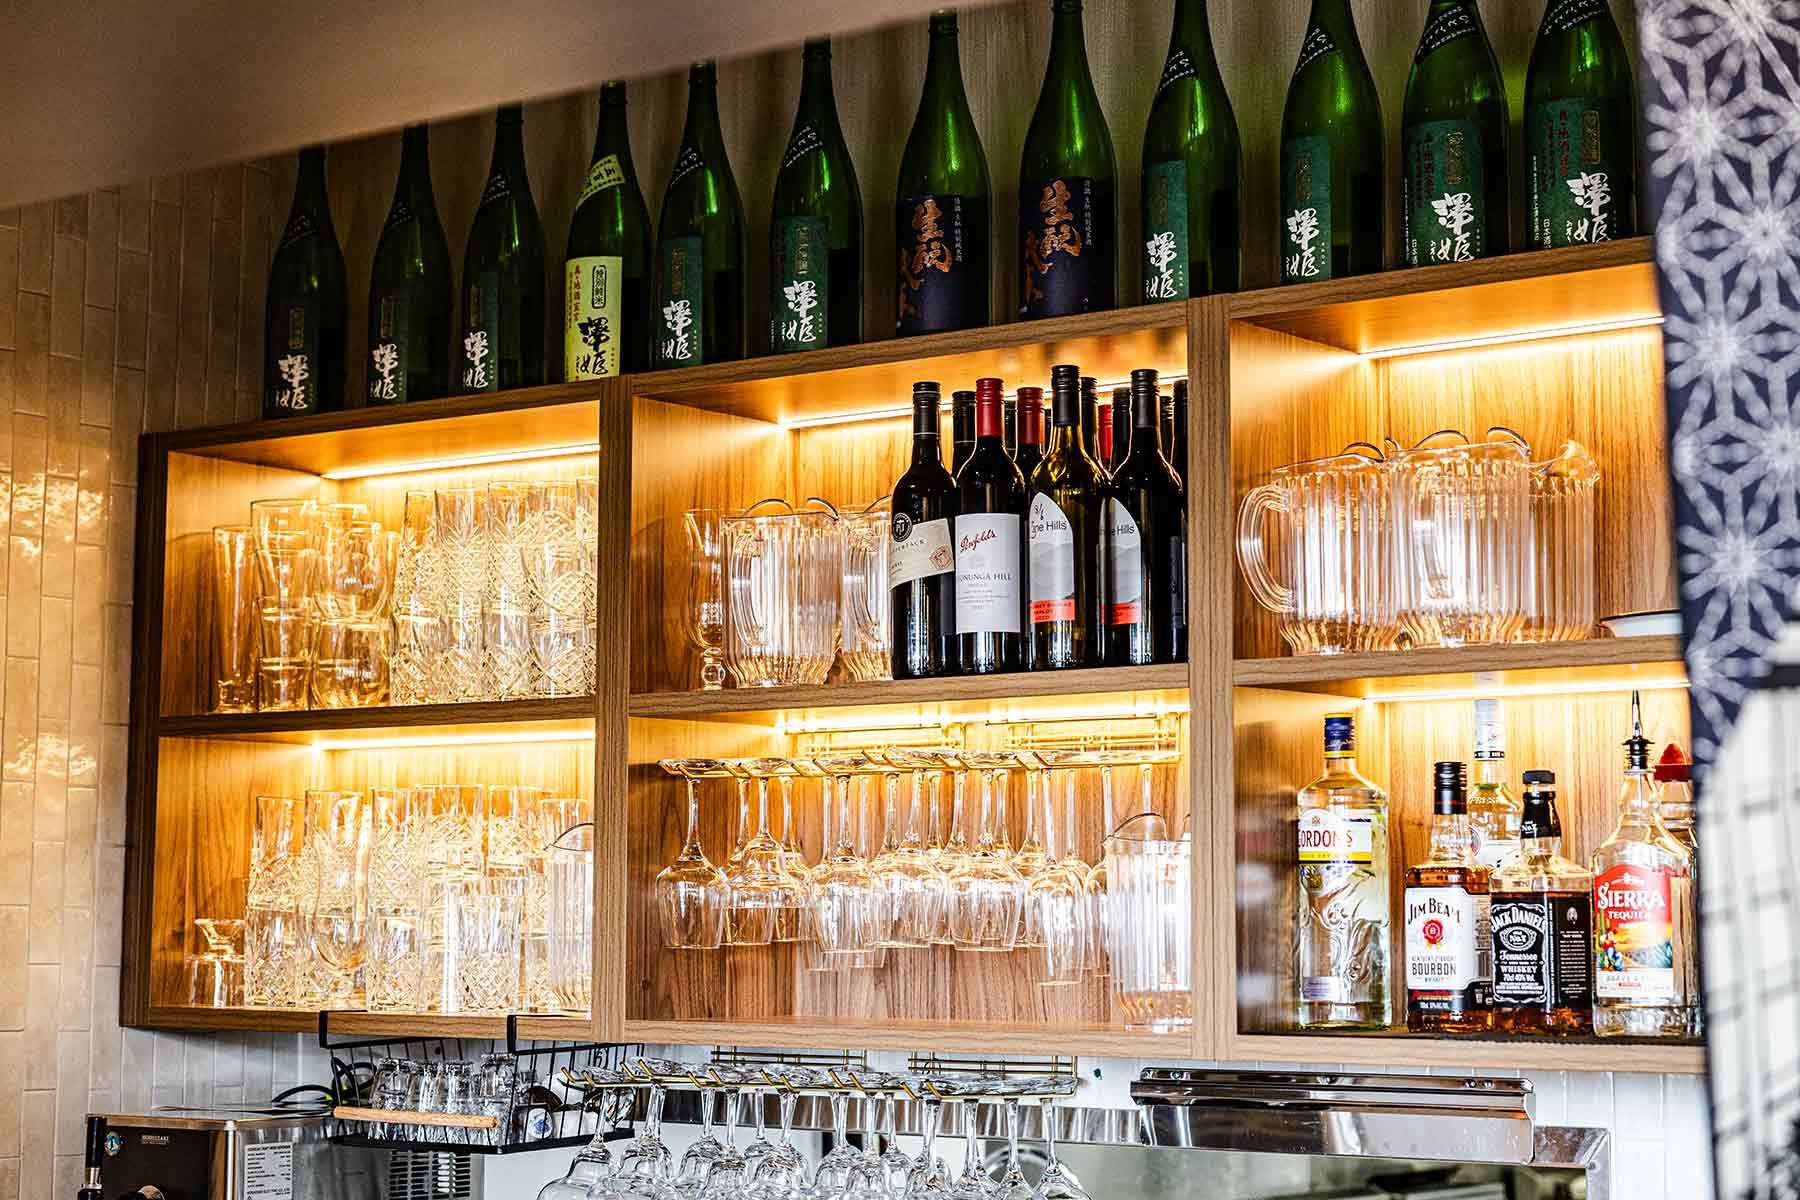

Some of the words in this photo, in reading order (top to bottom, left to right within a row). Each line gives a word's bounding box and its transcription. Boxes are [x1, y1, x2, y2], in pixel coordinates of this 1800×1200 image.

[1046, 520, 1067, 531] Hills
[1117, 526, 1134, 536] Hills
[1597, 881, 1665, 910] SIERRA
[1408, 903, 1426, 925] JIM
[1491, 911, 1512, 933] JACK
[1500, 950, 1537, 961] Tennessee
[1412, 962, 1457, 975] BOURBON
[1500, 965, 1538, 973] WHISKEY
